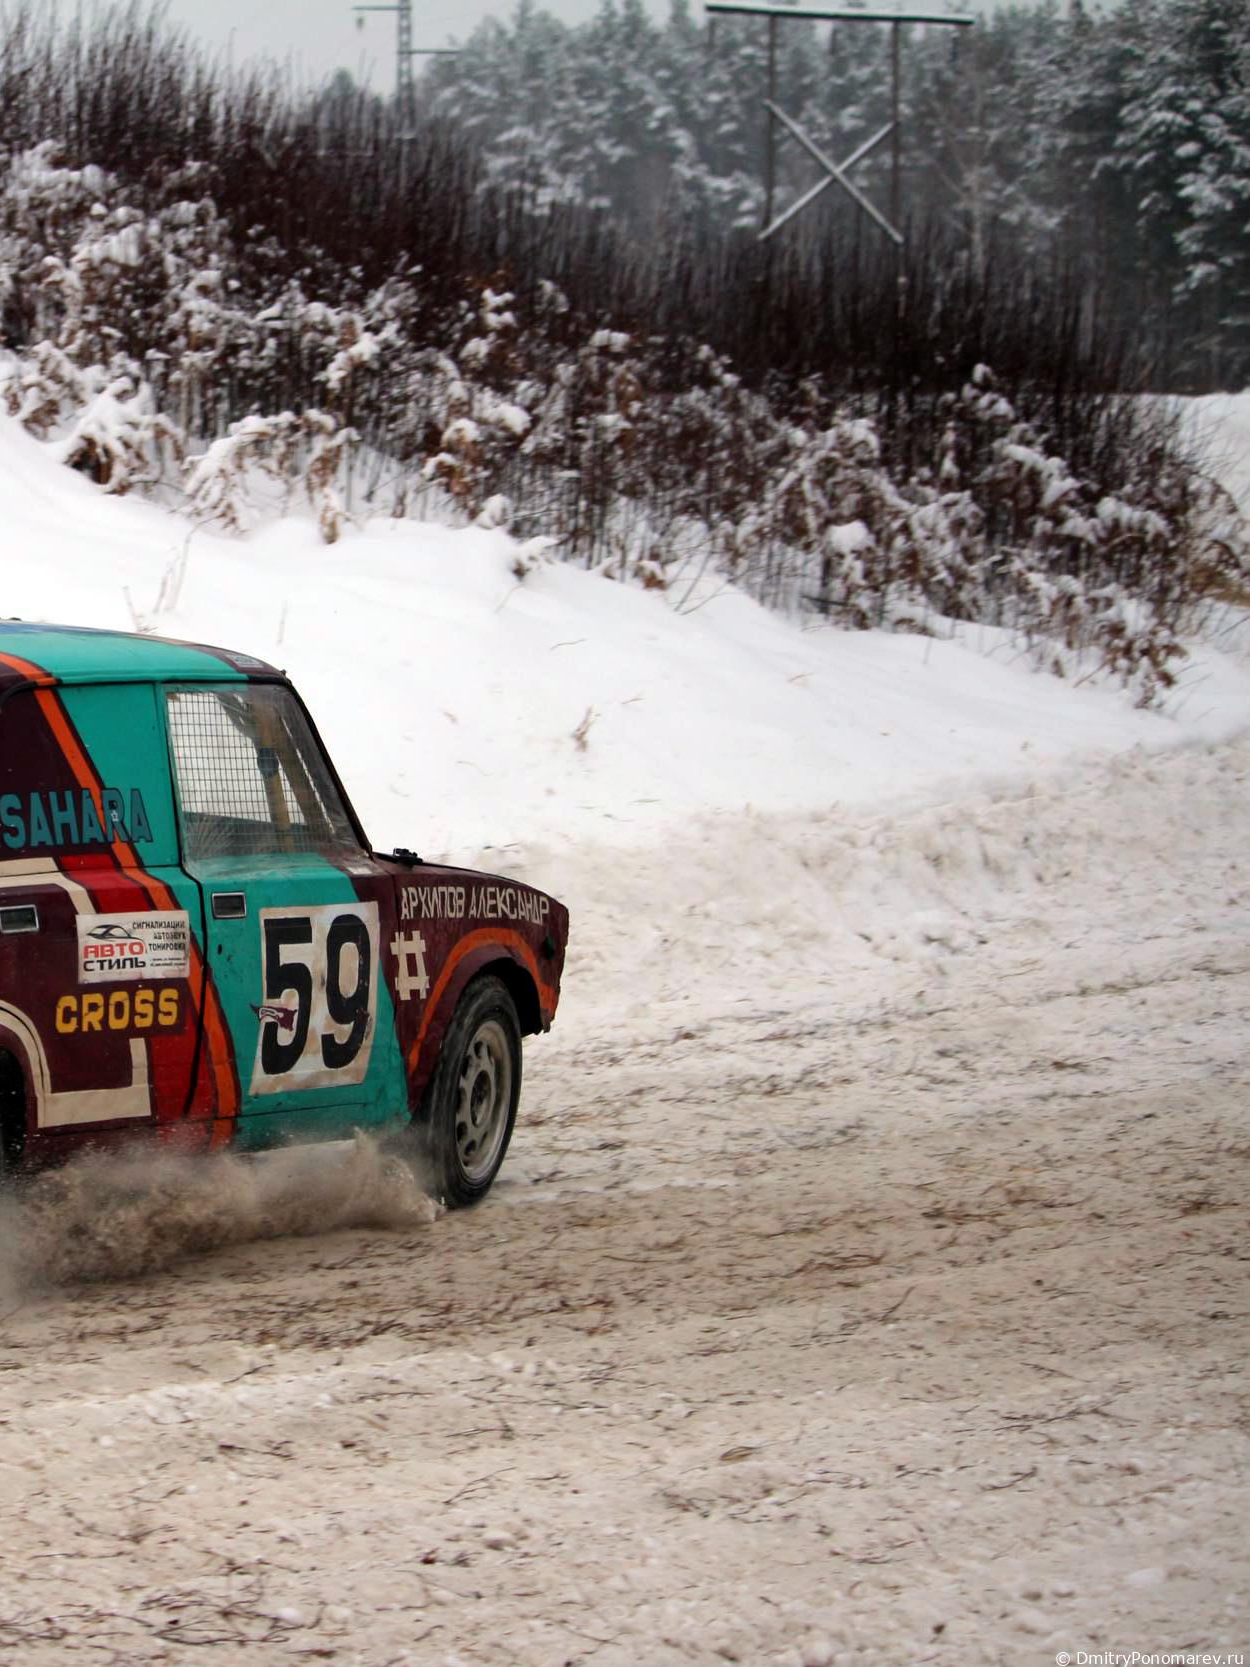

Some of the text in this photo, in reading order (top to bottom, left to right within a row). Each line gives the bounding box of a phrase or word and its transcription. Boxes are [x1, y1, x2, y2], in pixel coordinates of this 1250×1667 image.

[401, 886, 550, 925] АРХИПОВ АЛЕКСАНДР
[83, 941, 144, 958] АВТО
[83, 957, 146, 972] СТИЛЬ
[55, 988, 179, 1034] CROSS
[261, 914, 371, 1075] 59
